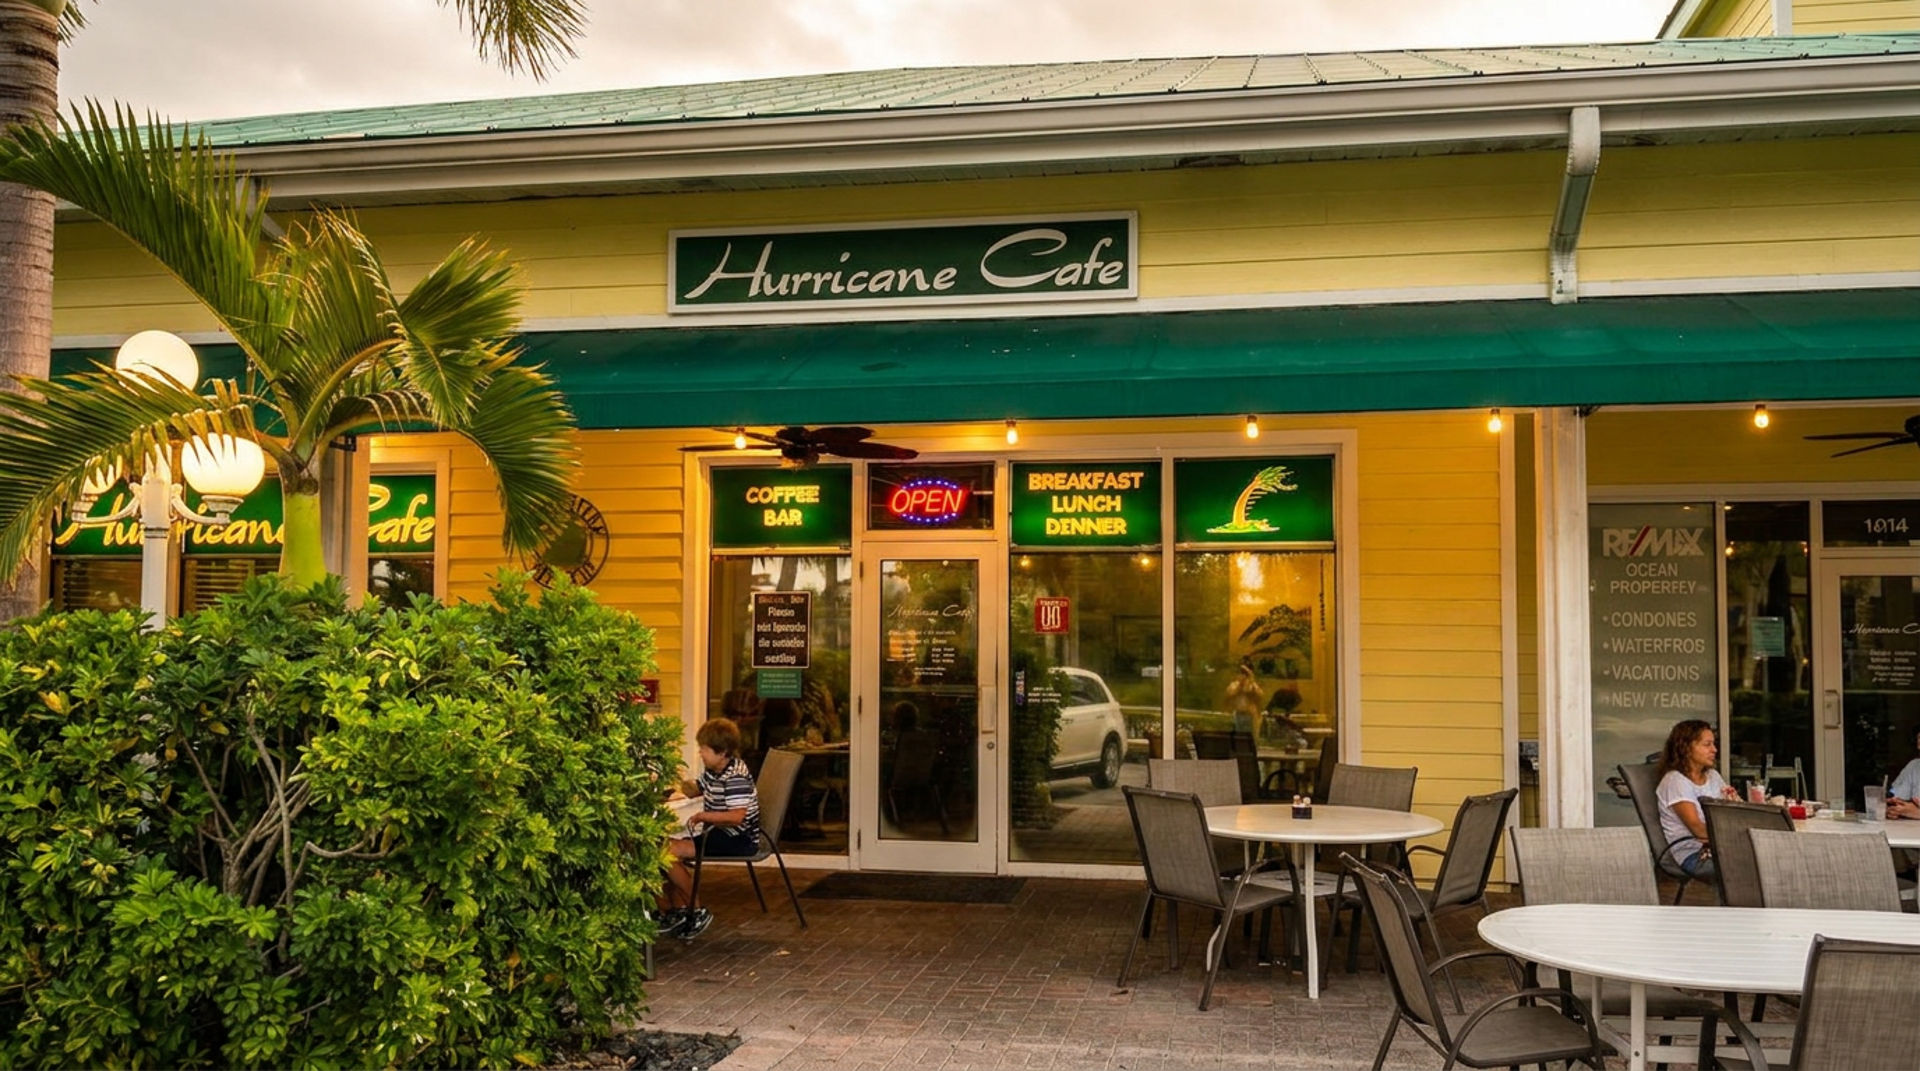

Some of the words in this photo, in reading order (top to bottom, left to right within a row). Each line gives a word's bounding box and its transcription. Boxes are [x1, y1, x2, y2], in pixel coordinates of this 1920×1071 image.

[684, 240, 958, 299] Hurricane
[980, 228, 1124, 289] Cafe
[1028, 471, 1144, 490] BREAKFAST
[745, 485, 820, 504] COFFEE
[892, 489, 963, 513] OPEN
[1052, 495, 1121, 513] LUNCH
[763, 509, 802, 526] BAR
[1046, 517, 1127, 535] DINNER
[1626, 563, 1678, 577] OCEAN
[1611, 612, 1698, 627] CONDONES
[1611, 637, 1705, 654] WATERFROS
[1611, 665, 1700, 681] VACATIONS
[1612, 692, 1646, 708] NEW
